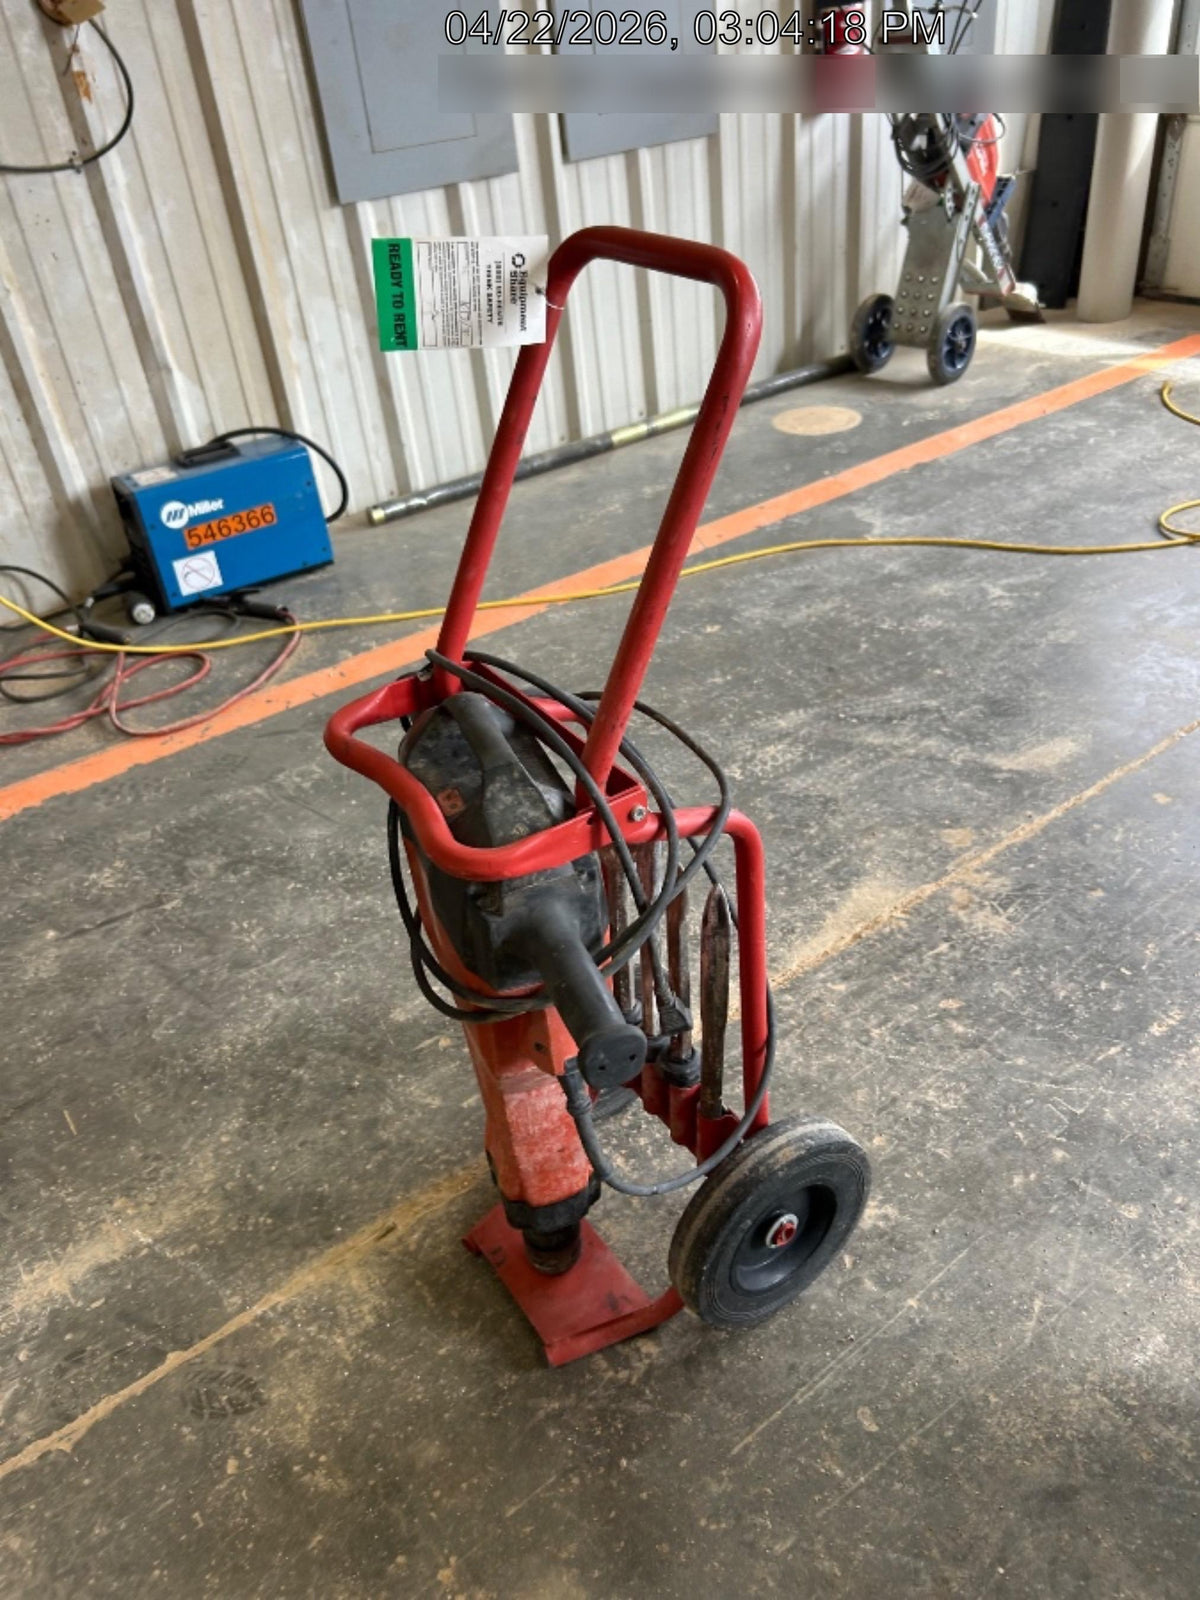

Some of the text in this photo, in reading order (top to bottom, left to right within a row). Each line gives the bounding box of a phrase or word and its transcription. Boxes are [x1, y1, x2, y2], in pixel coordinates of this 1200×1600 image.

[388, 243, 408, 347] READY TO RENT
[486, 292, 494, 323] SAFETY
[510, 270, 518, 305] Share
[519, 270, 528, 331] Equipment
[187, 504, 275, 549] 546366
[188, 499, 224, 518] Miller
